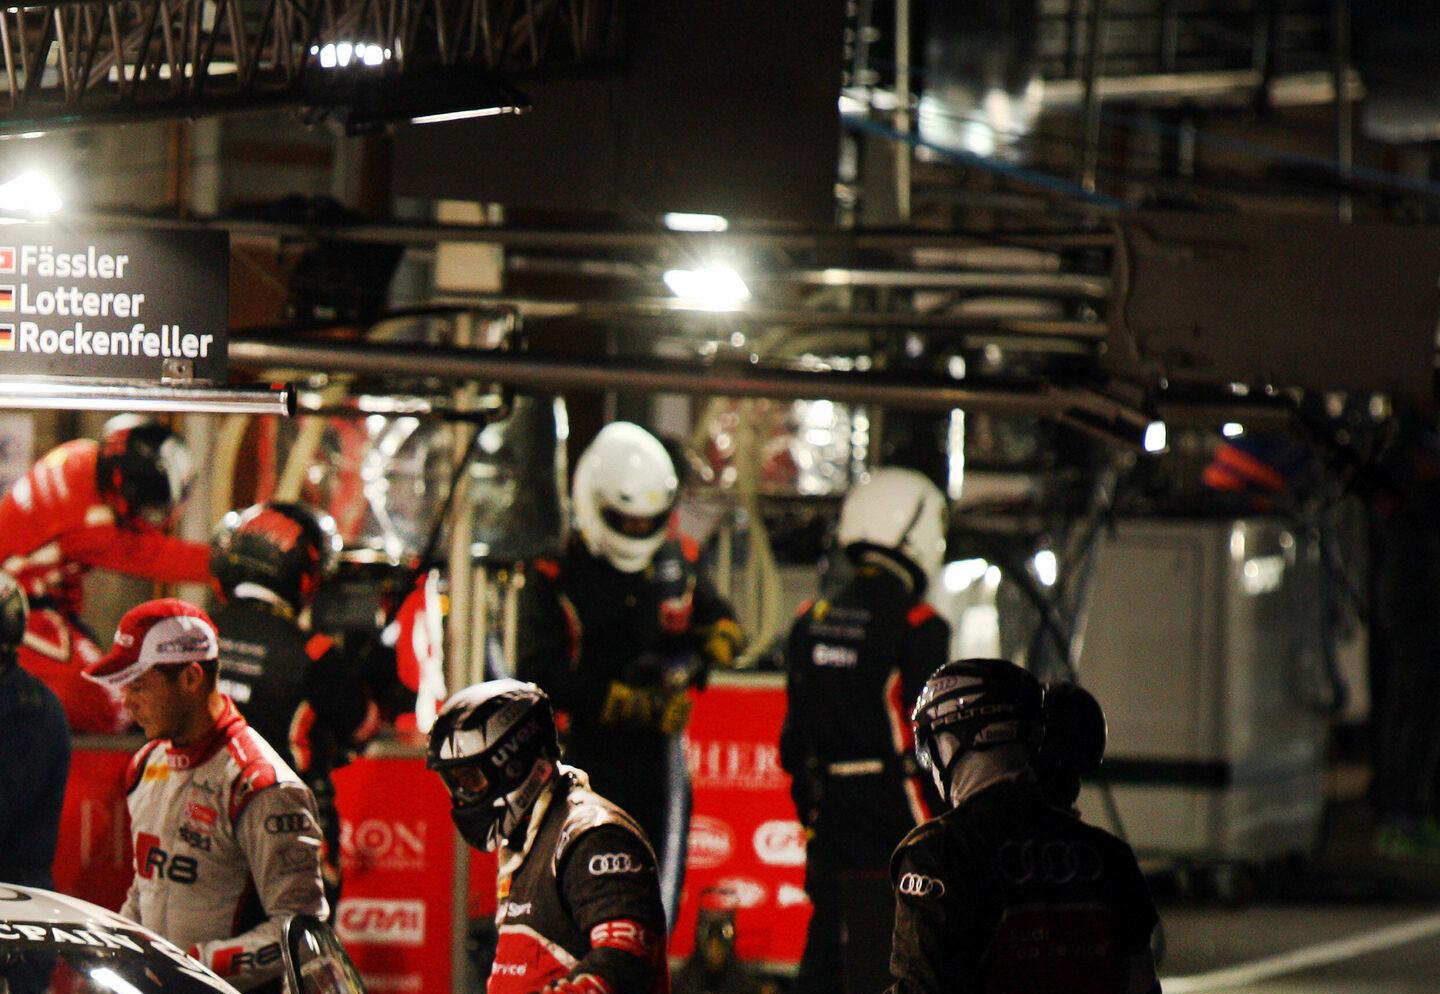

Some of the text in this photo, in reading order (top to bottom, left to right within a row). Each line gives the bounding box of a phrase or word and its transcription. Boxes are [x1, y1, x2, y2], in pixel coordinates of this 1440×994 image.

[20, 245, 130, 279] Fässler
[20, 284, 145, 318] Lotterer
[19, 321, 213, 359] Rockenfeller
[146, 846, 199, 884] R8
